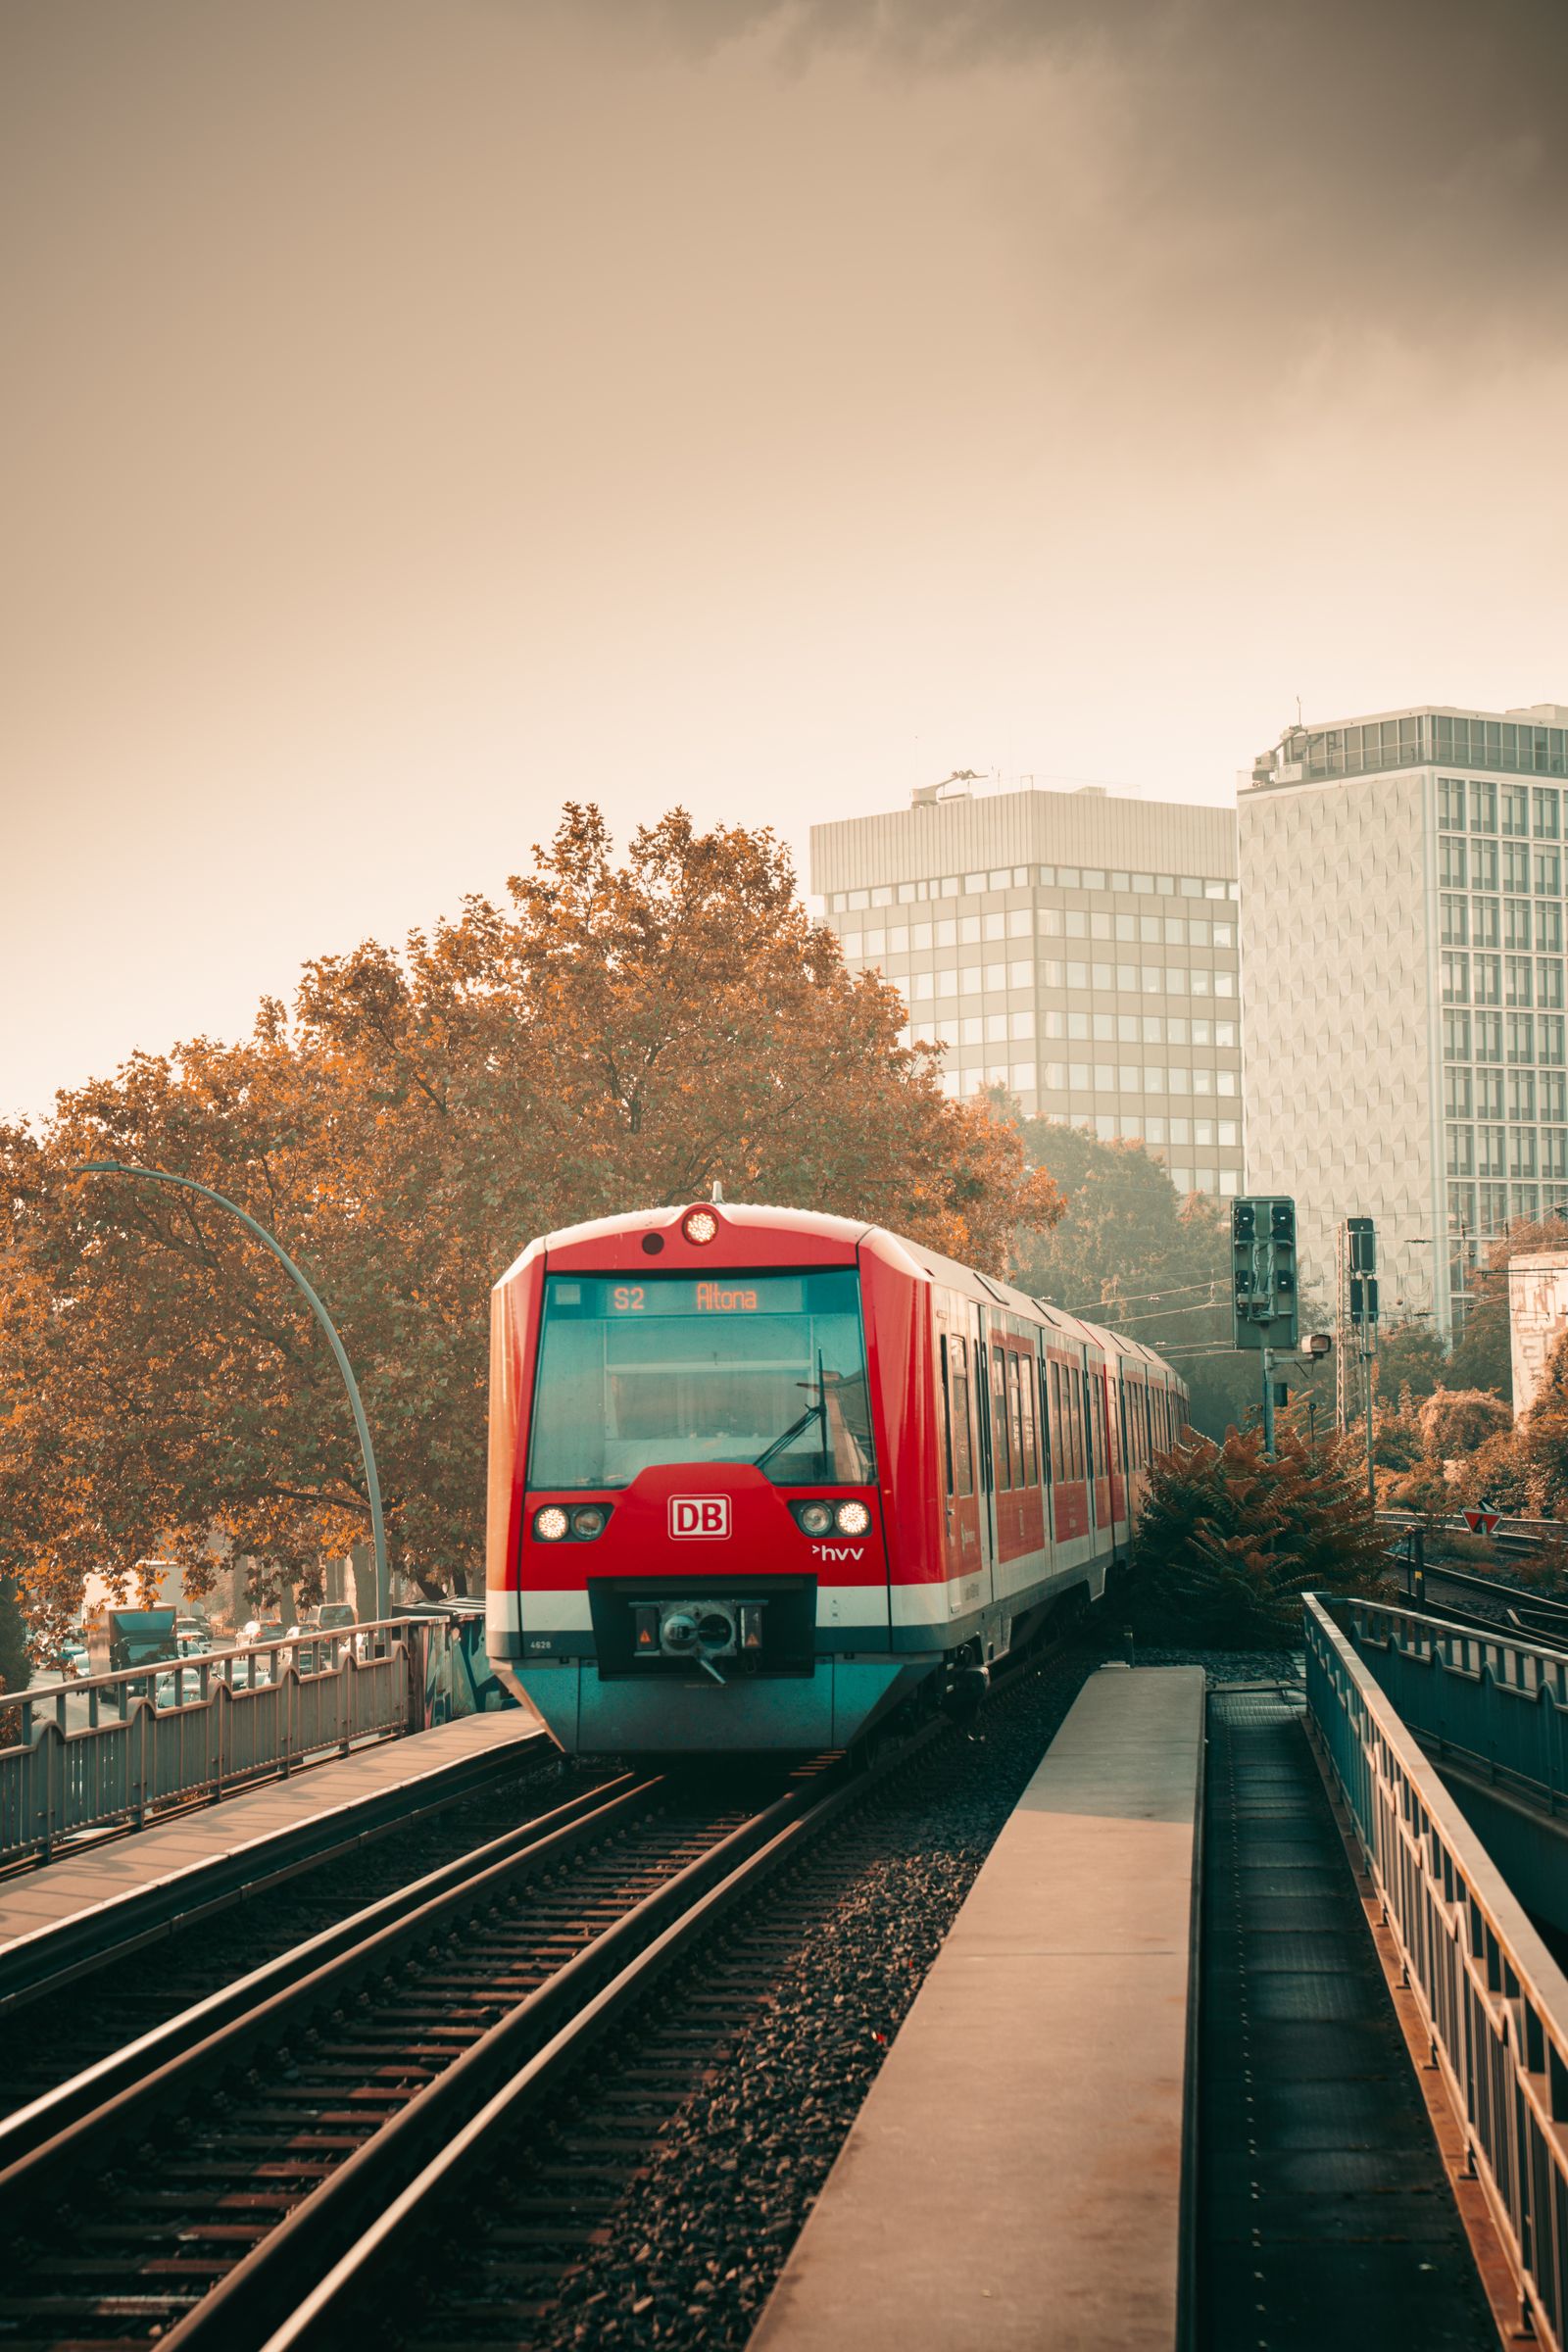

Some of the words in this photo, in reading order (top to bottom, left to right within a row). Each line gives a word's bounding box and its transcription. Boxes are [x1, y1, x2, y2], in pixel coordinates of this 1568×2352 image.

[613, 1287, 645, 1310] S2
[697, 1282, 758, 1310] Altona
[676, 1502, 723, 1533] DB
